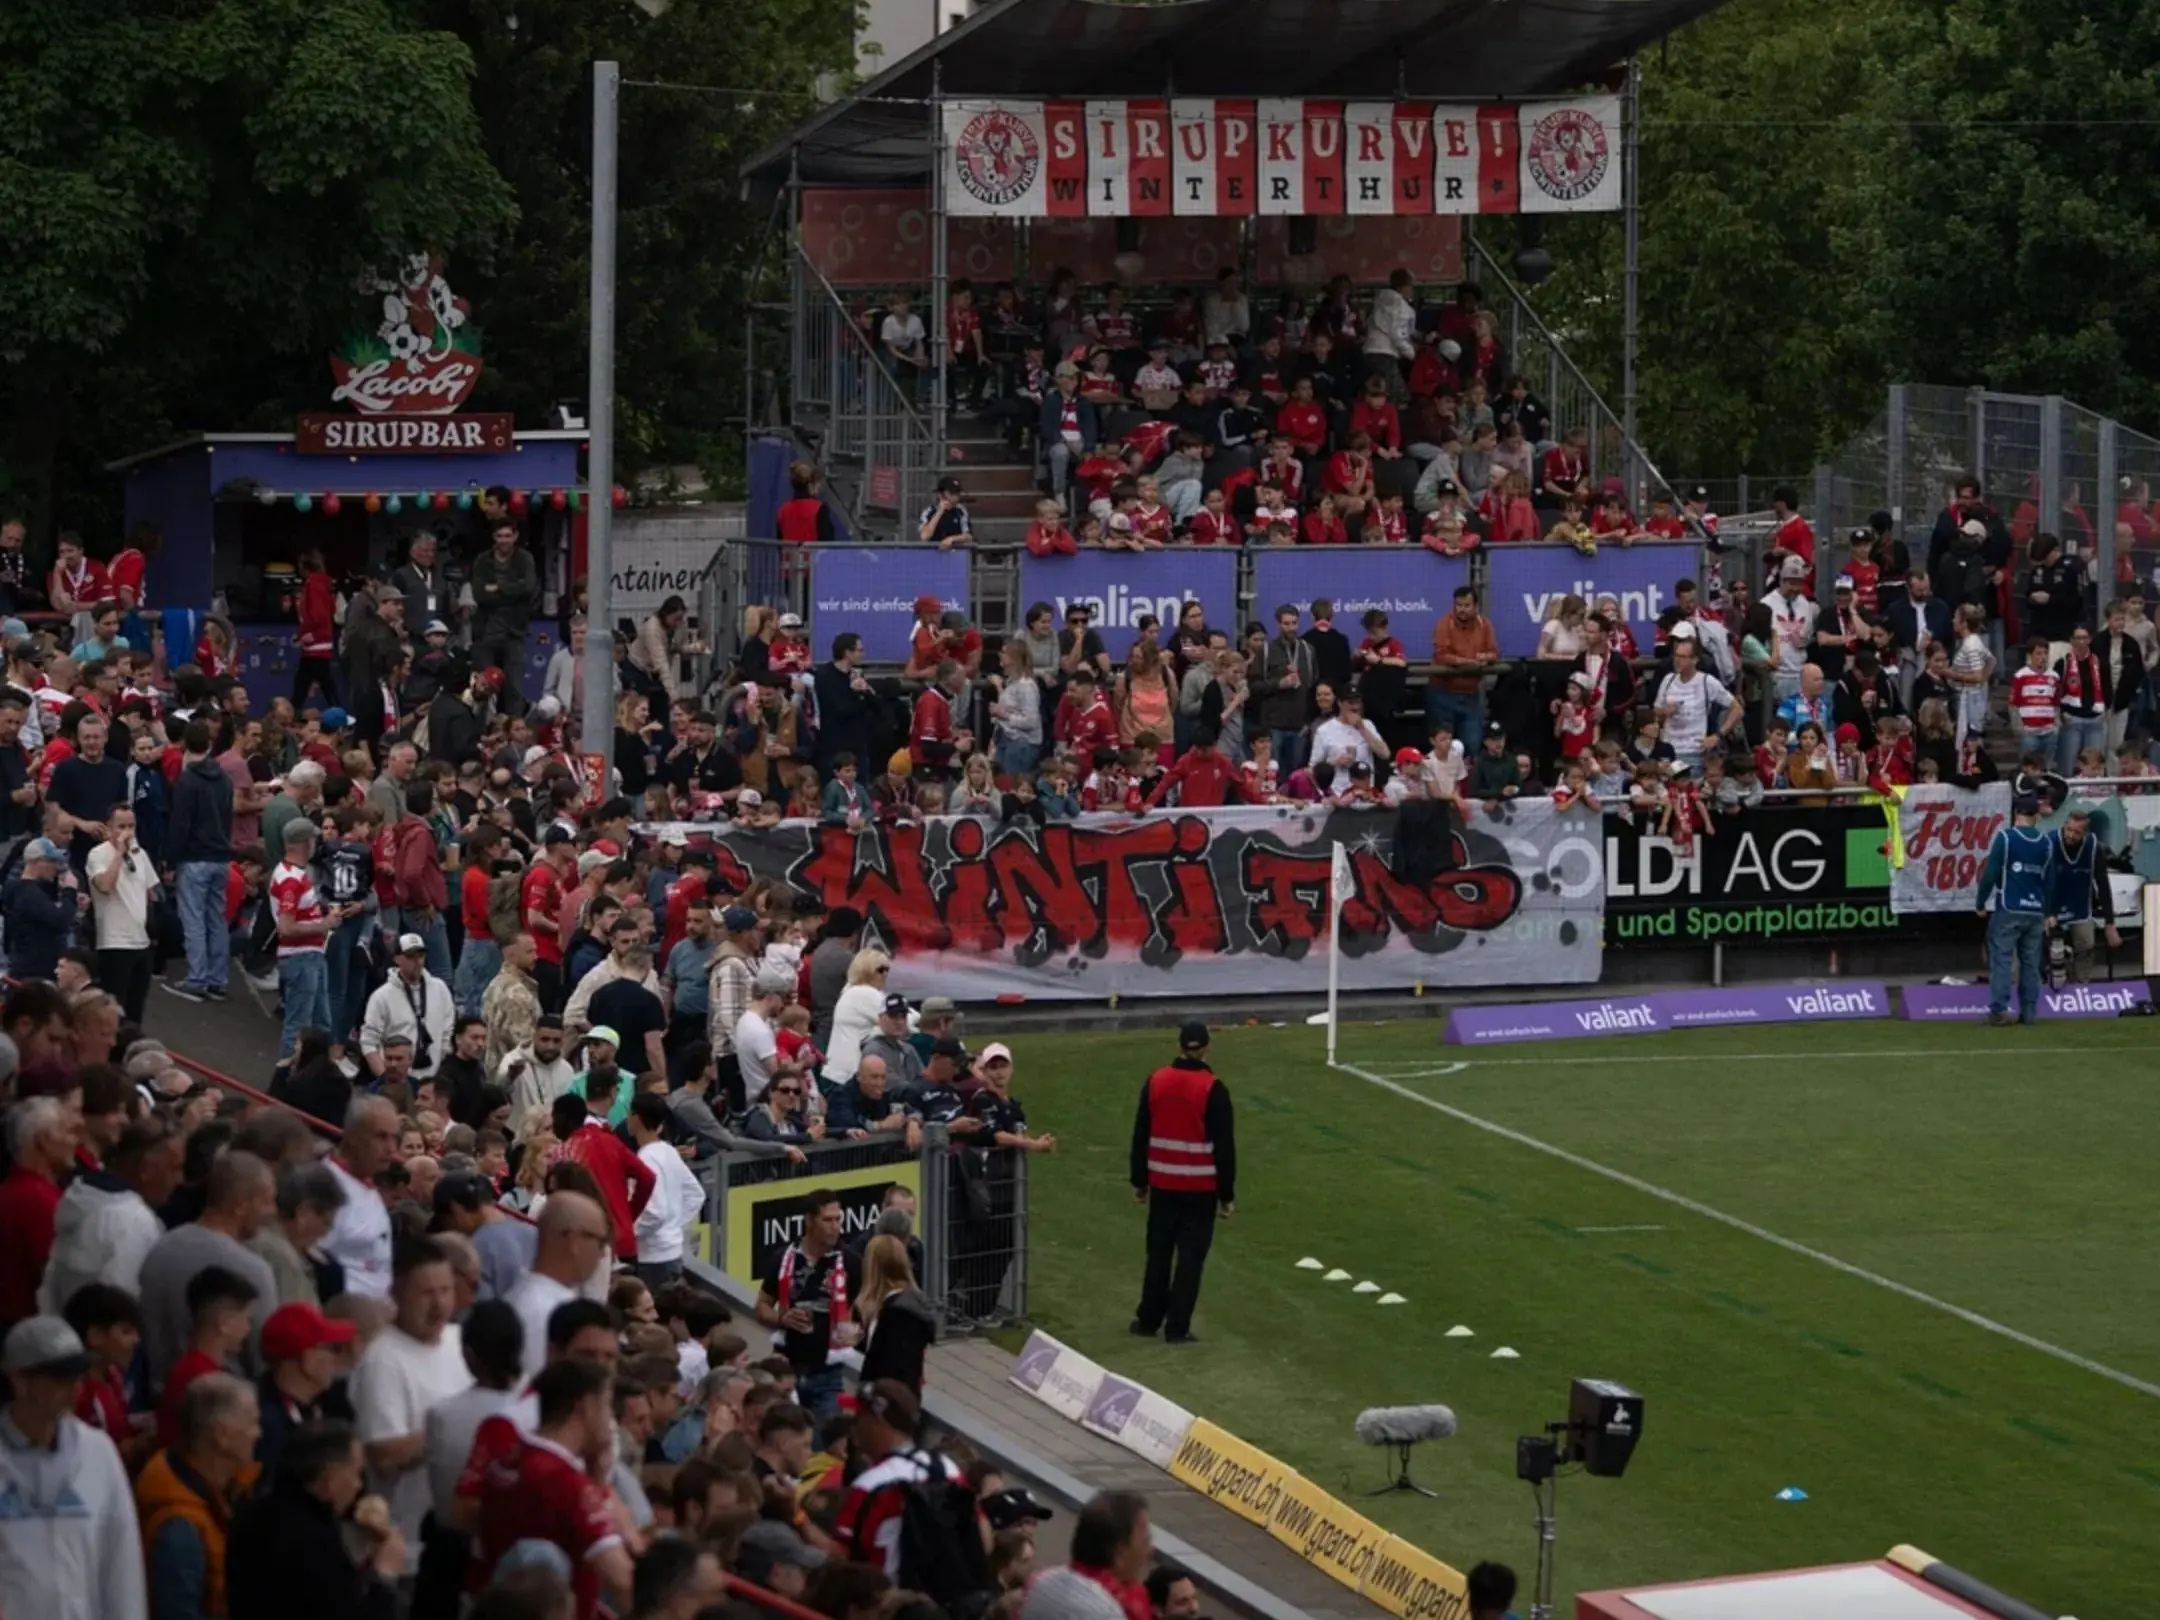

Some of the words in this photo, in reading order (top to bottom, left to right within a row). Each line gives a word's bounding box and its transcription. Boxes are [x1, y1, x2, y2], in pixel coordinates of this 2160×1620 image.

[1053, 118, 1505, 162] SIRUPKURVE!
[1052, 176, 1464, 201] WINTERTHUR
[324, 419, 486, 448] SIRUPBAR
[817, 597, 840, 612] wir
[841, 597, 870, 612] sind
[1395, 597, 1433, 612] bank.
[1724, 829, 1827, 893] AG
[333, 862, 358, 893] 10
[1617, 908, 1676, 937] und
[1686, 903, 1899, 940] Sportplatzbau
[1785, 988, 1876, 1014] valiant
[2045, 987, 2136, 1013] valiant
[1575, 1003, 1656, 1031] valiant
[1176, 1436, 1282, 1513] www.gpard.ch
[1275, 1493, 1377, 1578] www.gpard.ch
